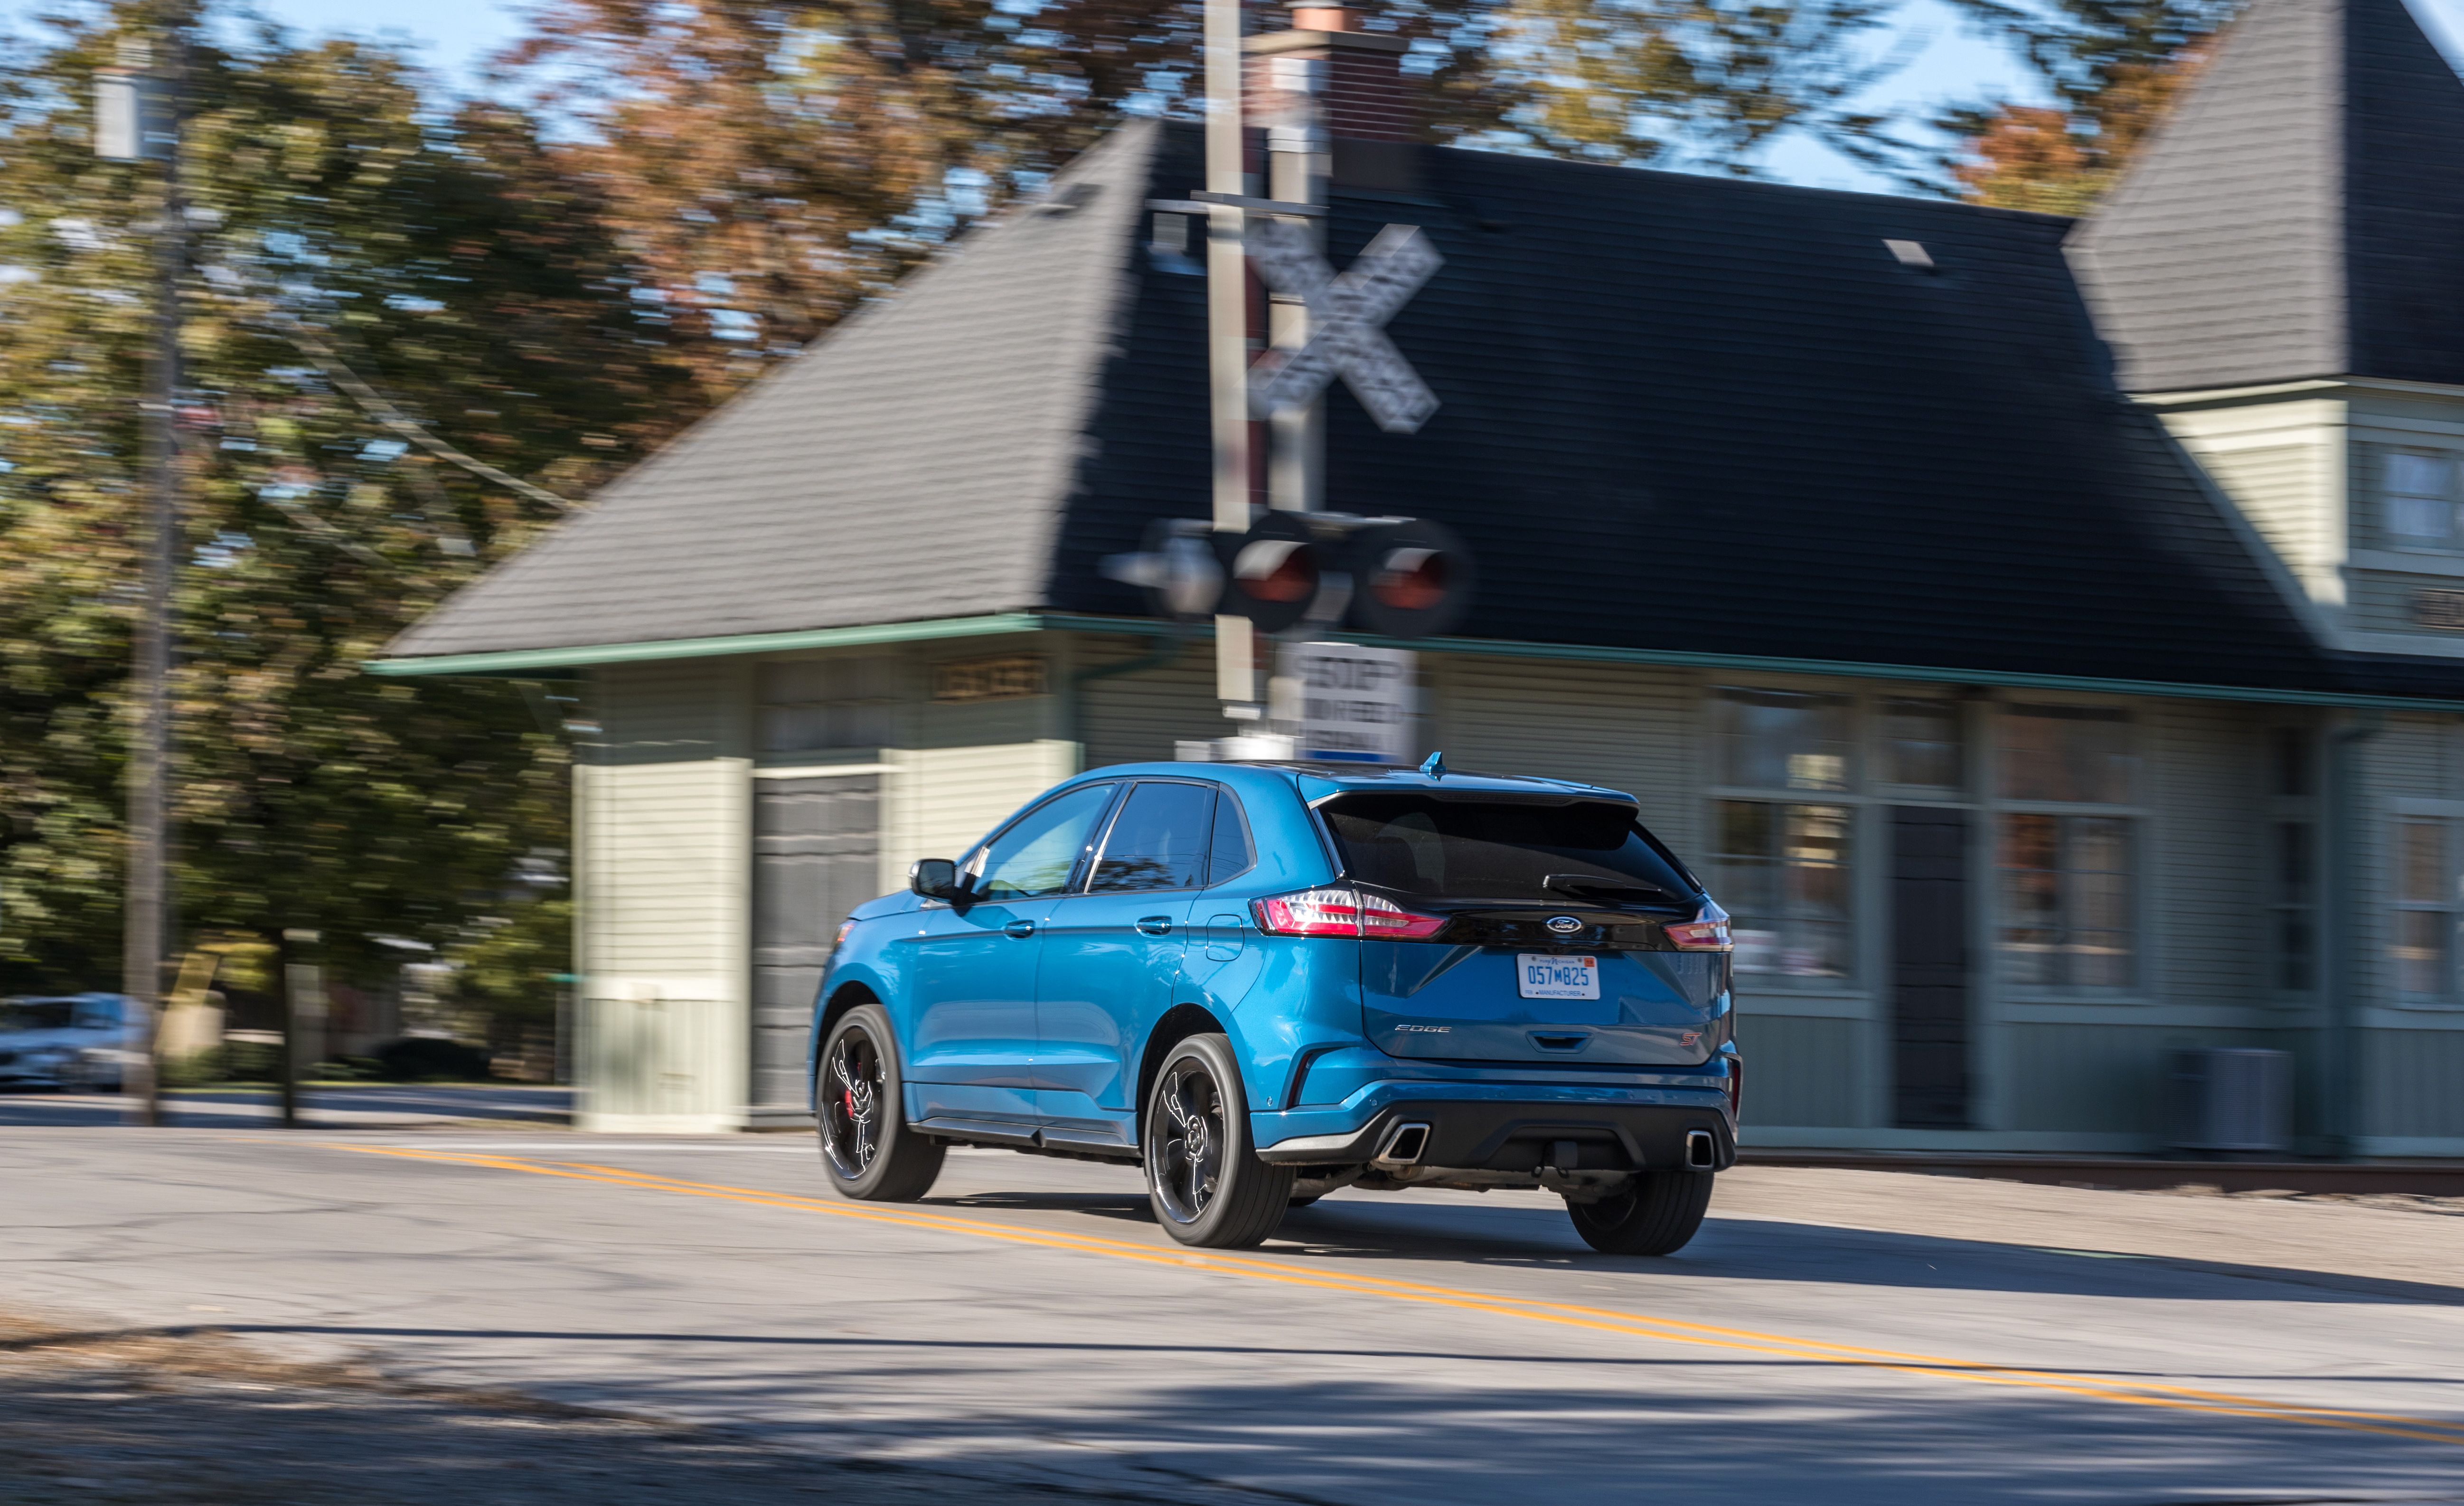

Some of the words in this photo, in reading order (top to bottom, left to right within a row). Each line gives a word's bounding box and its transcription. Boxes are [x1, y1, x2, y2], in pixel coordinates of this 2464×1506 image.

[1555, 920, 1575, 929] Ford
[1528, 965, 1589, 986] 057M825
[1395, 1024, 1452, 1033] EDGE
[1679, 1032, 1702, 1046] ST
